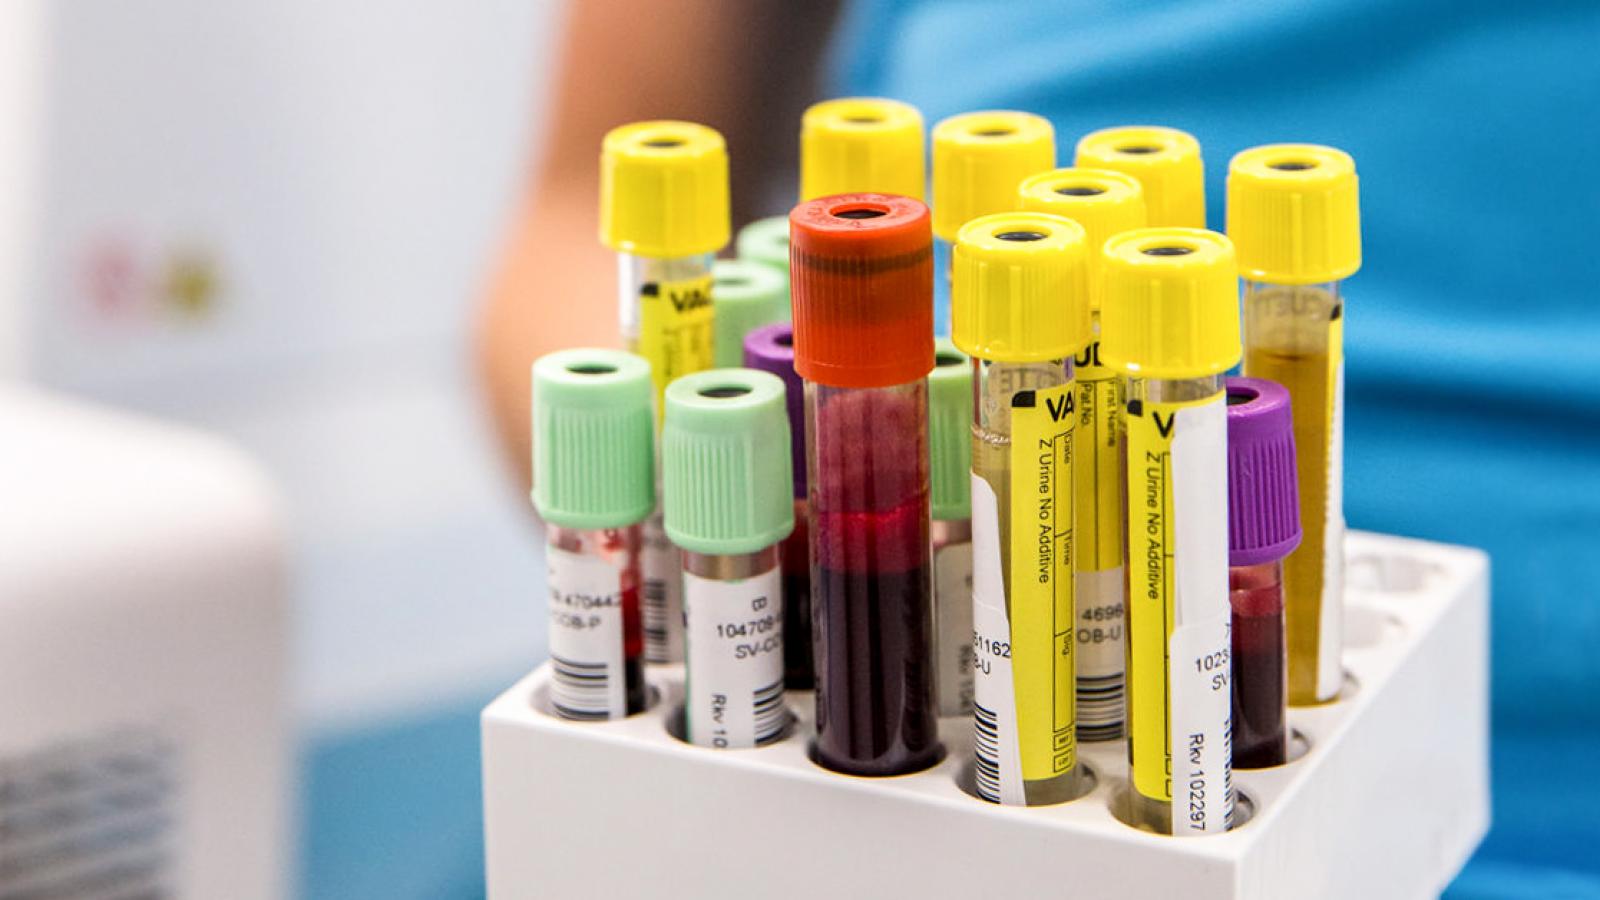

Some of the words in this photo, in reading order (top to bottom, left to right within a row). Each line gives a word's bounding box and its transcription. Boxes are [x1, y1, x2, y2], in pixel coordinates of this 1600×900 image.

[1039, 439, 1052, 449] Z
[1146, 452, 1160, 463] Z
[1039, 453, 1052, 494] Urine
[1146, 467, 1160, 508] Urine
[1039, 498, 1052, 520] No
[1147, 513, 1160, 535] No
[1039, 524, 1052, 584] Additive
[1147, 538, 1160, 600] Additive
[1189, 733, 1204, 764] Rkv
[1189, 770, 1206, 831] 102297
